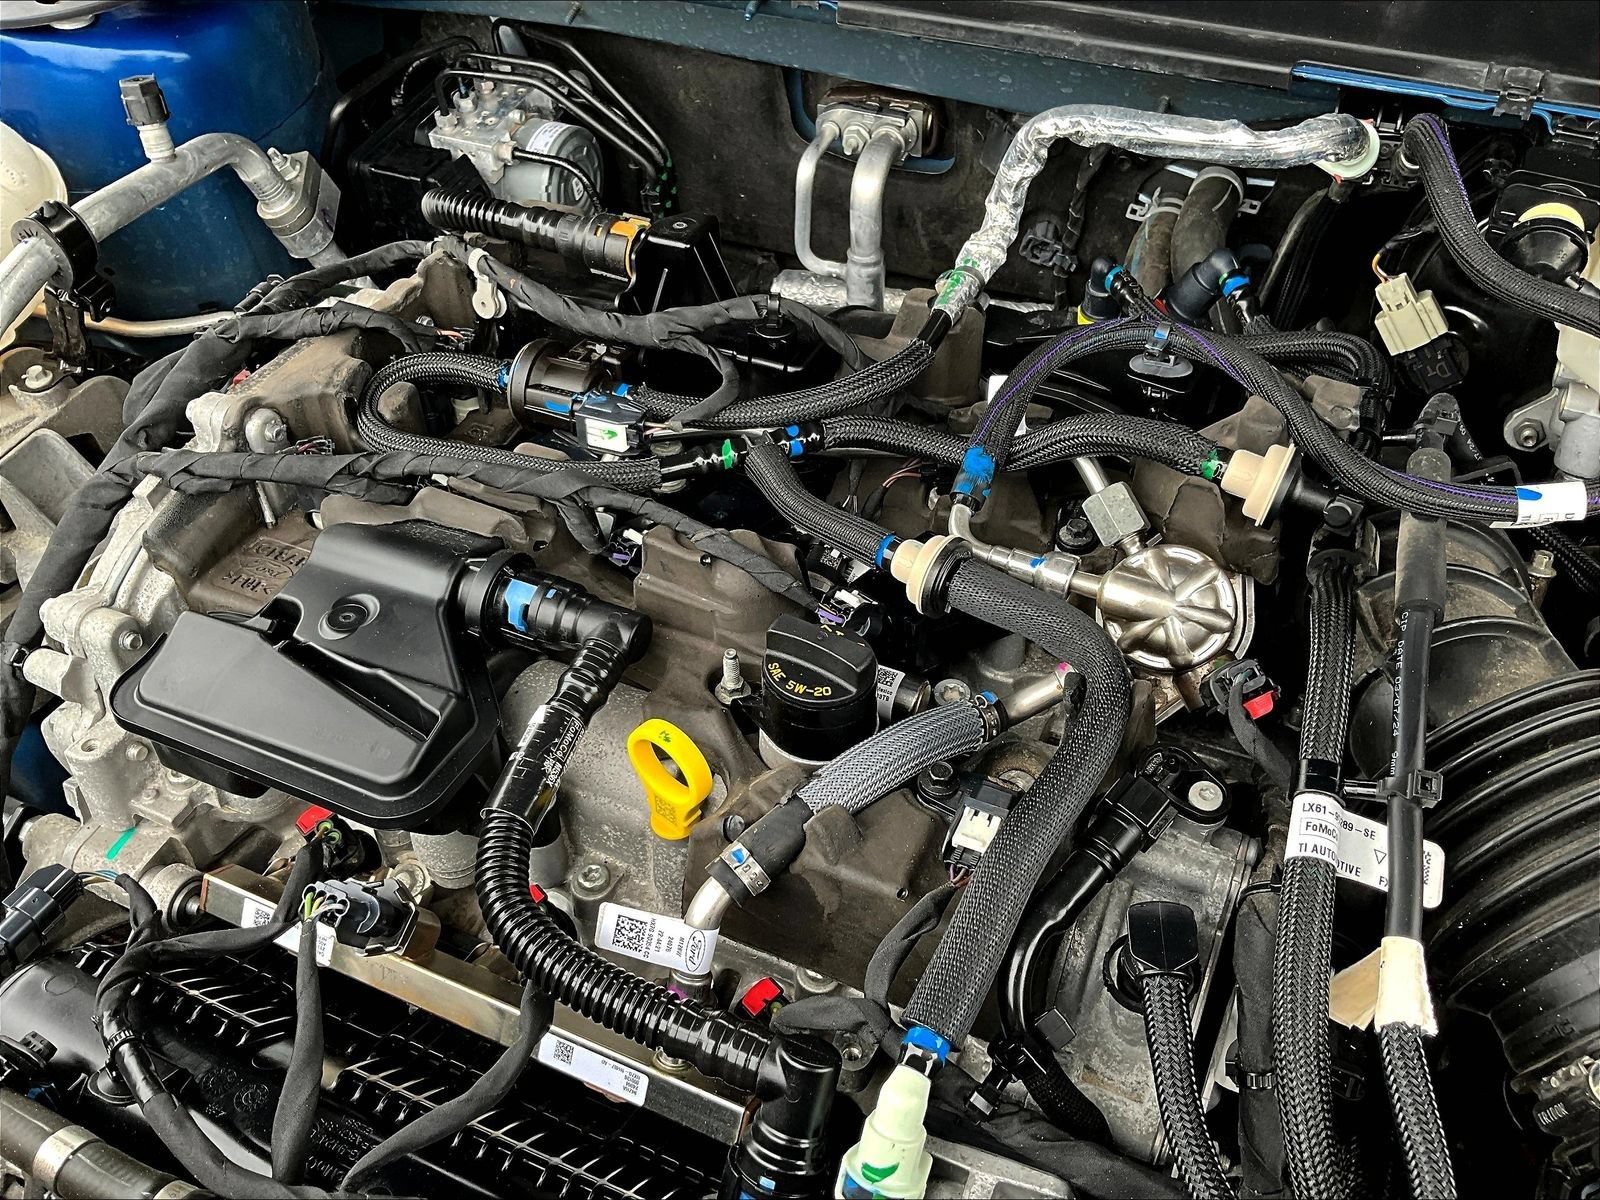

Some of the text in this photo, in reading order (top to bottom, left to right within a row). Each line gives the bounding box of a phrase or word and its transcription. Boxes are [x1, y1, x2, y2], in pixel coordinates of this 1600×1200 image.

[768, 662, 832, 697] SAE 5W-20
[1390, 611, 1409, 775] CIP DATE 03/07/24 9mm
[556, 719, 582, 757] FoMoCo
[1298, 843, 1361, 877] TI AUTOTIVE
[689, 936, 702, 966] Ford
